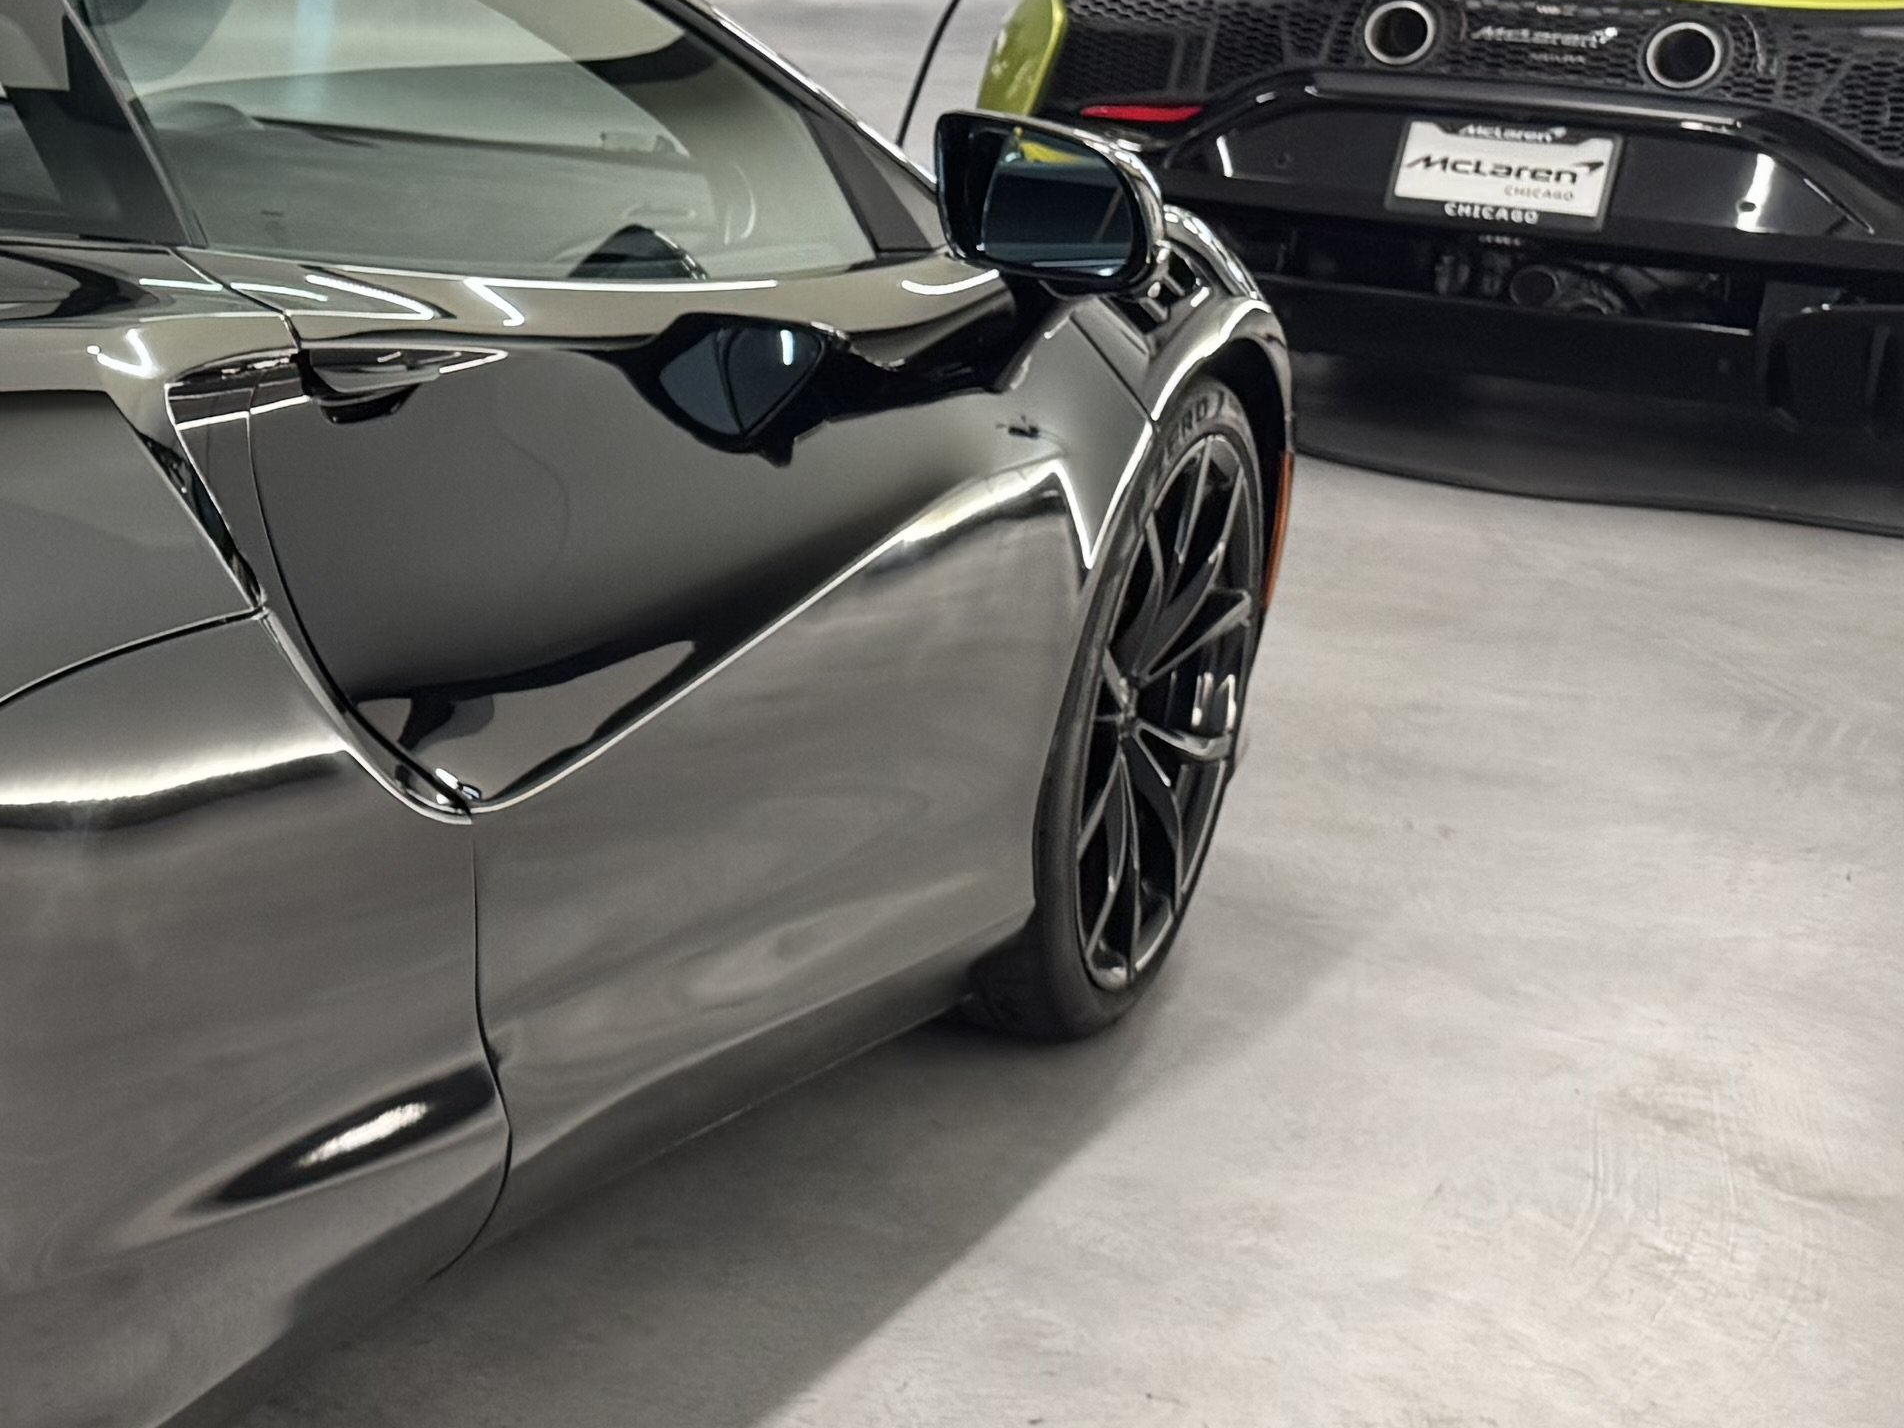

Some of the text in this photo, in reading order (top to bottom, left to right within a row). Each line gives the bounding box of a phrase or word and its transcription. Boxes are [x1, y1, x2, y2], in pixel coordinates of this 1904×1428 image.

[1406, 154, 1578, 185] McLaren
[1503, 185, 1575, 201] CHICAGO
[1444, 202, 1539, 225] CHICAGO
